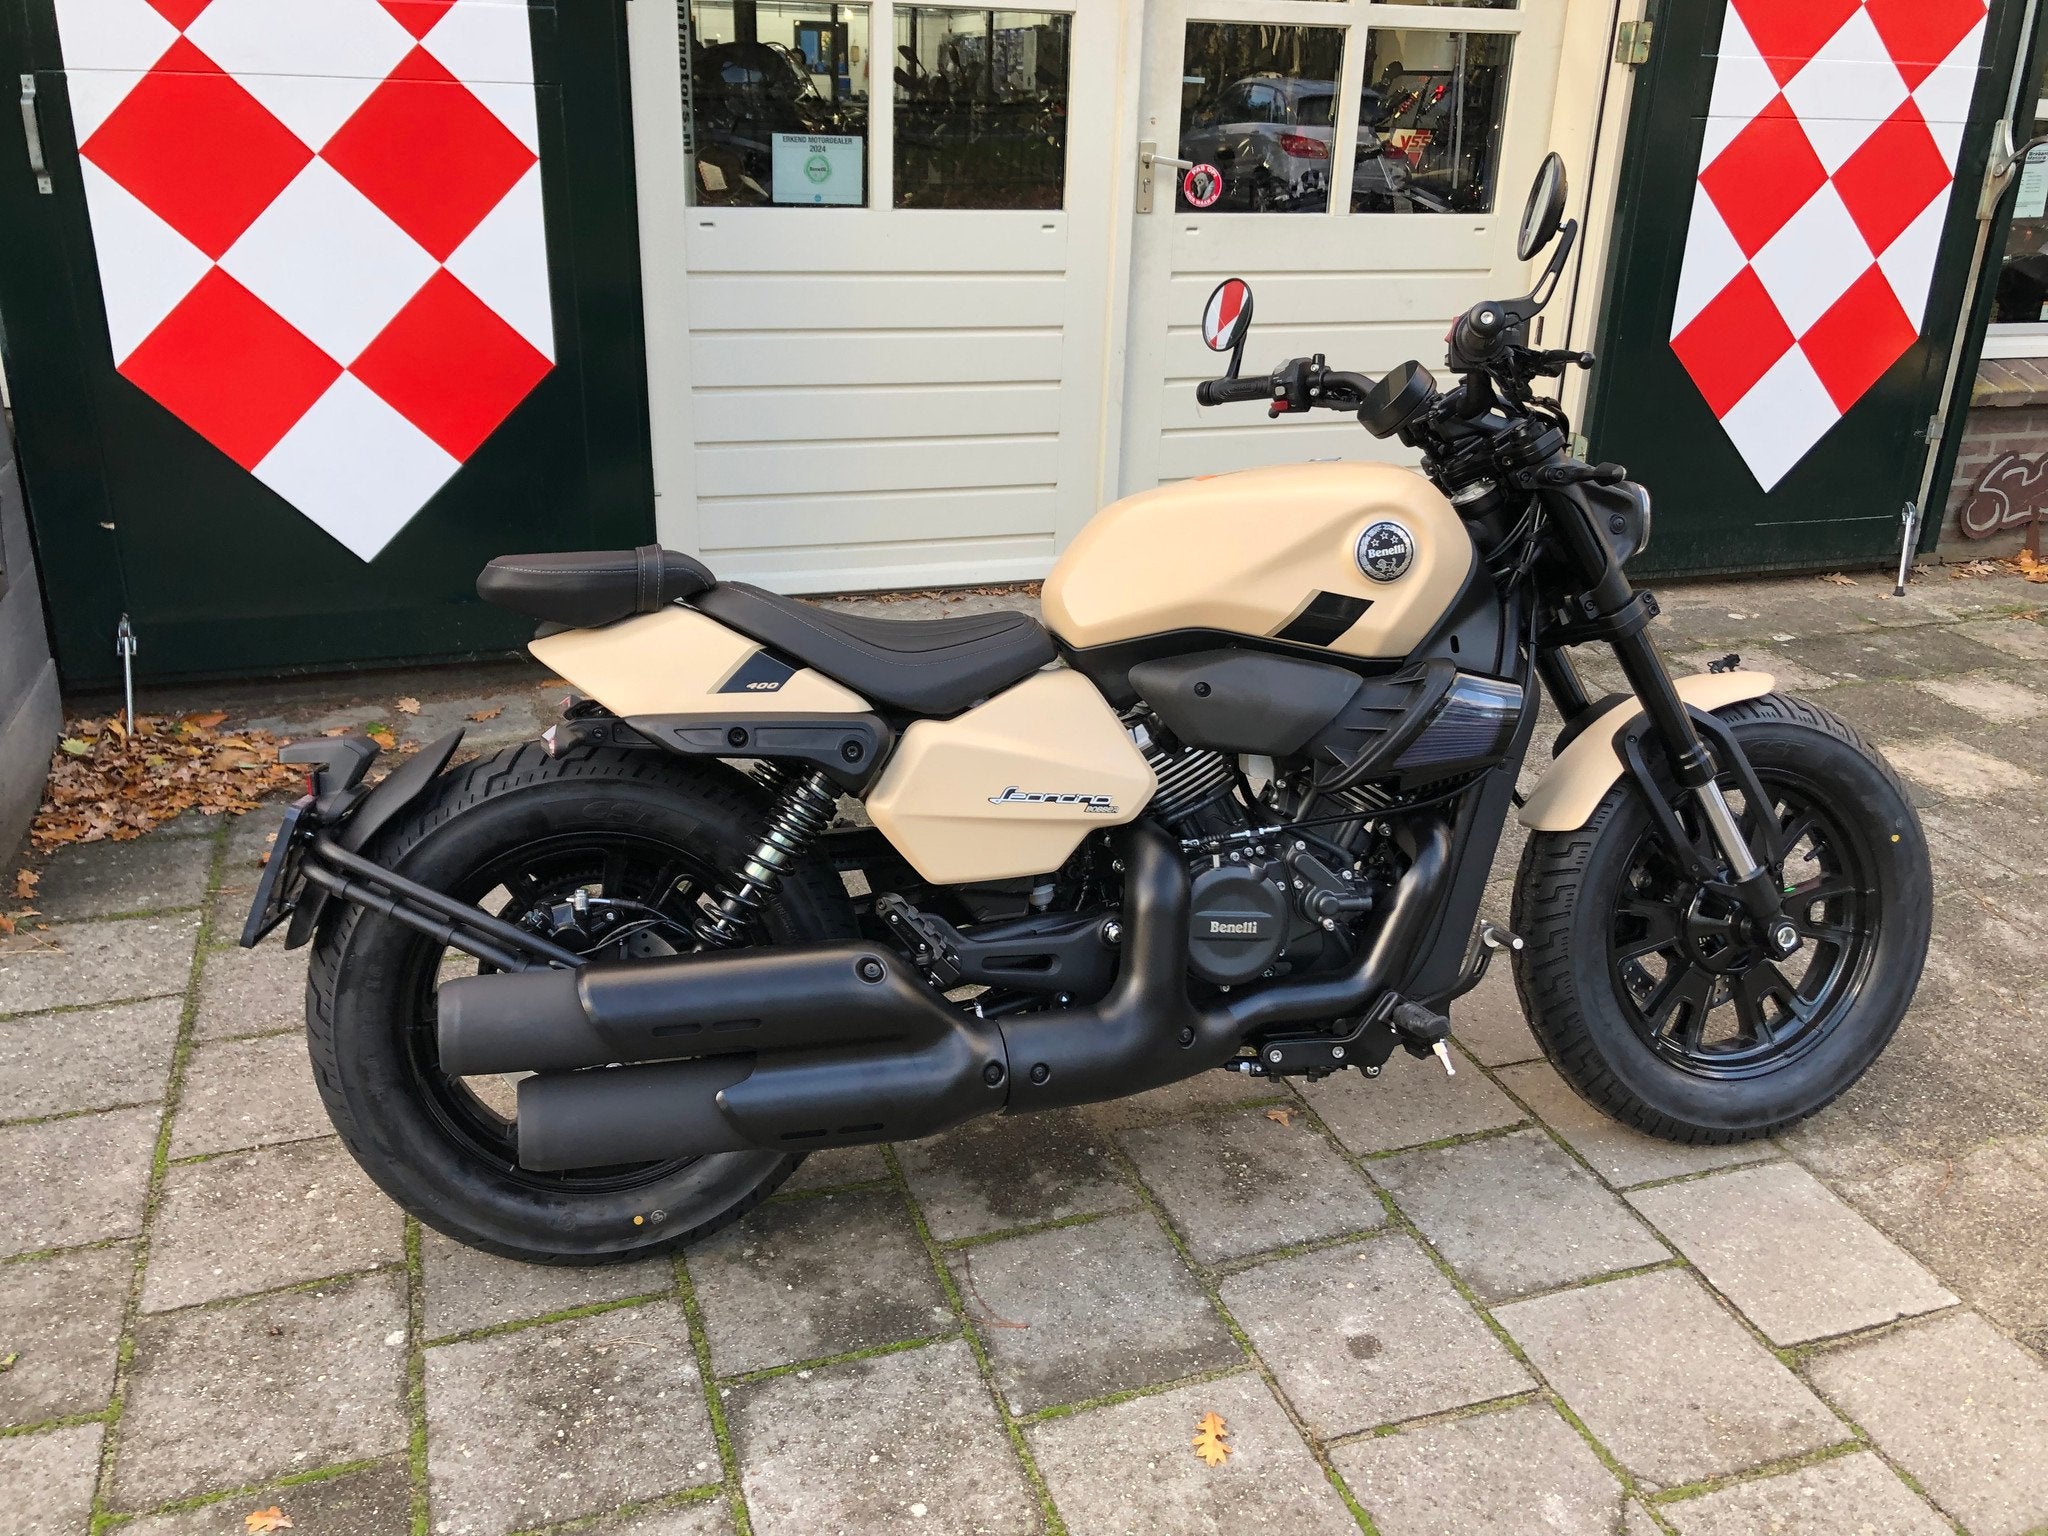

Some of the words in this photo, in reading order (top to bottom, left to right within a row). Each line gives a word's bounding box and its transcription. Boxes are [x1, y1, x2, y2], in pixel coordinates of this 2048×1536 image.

[677, 0, 693, 155] ntmotors.nl
[782, 135, 806, 143] ERKEND
[808, 136, 853, 144] MOTORDEALER
[809, 145, 826, 153] 2024
[1367, 543, 1406, 559] Benelli
[746, 682, 779, 690] 400
[1210, 921, 1258, 934] Benelli
